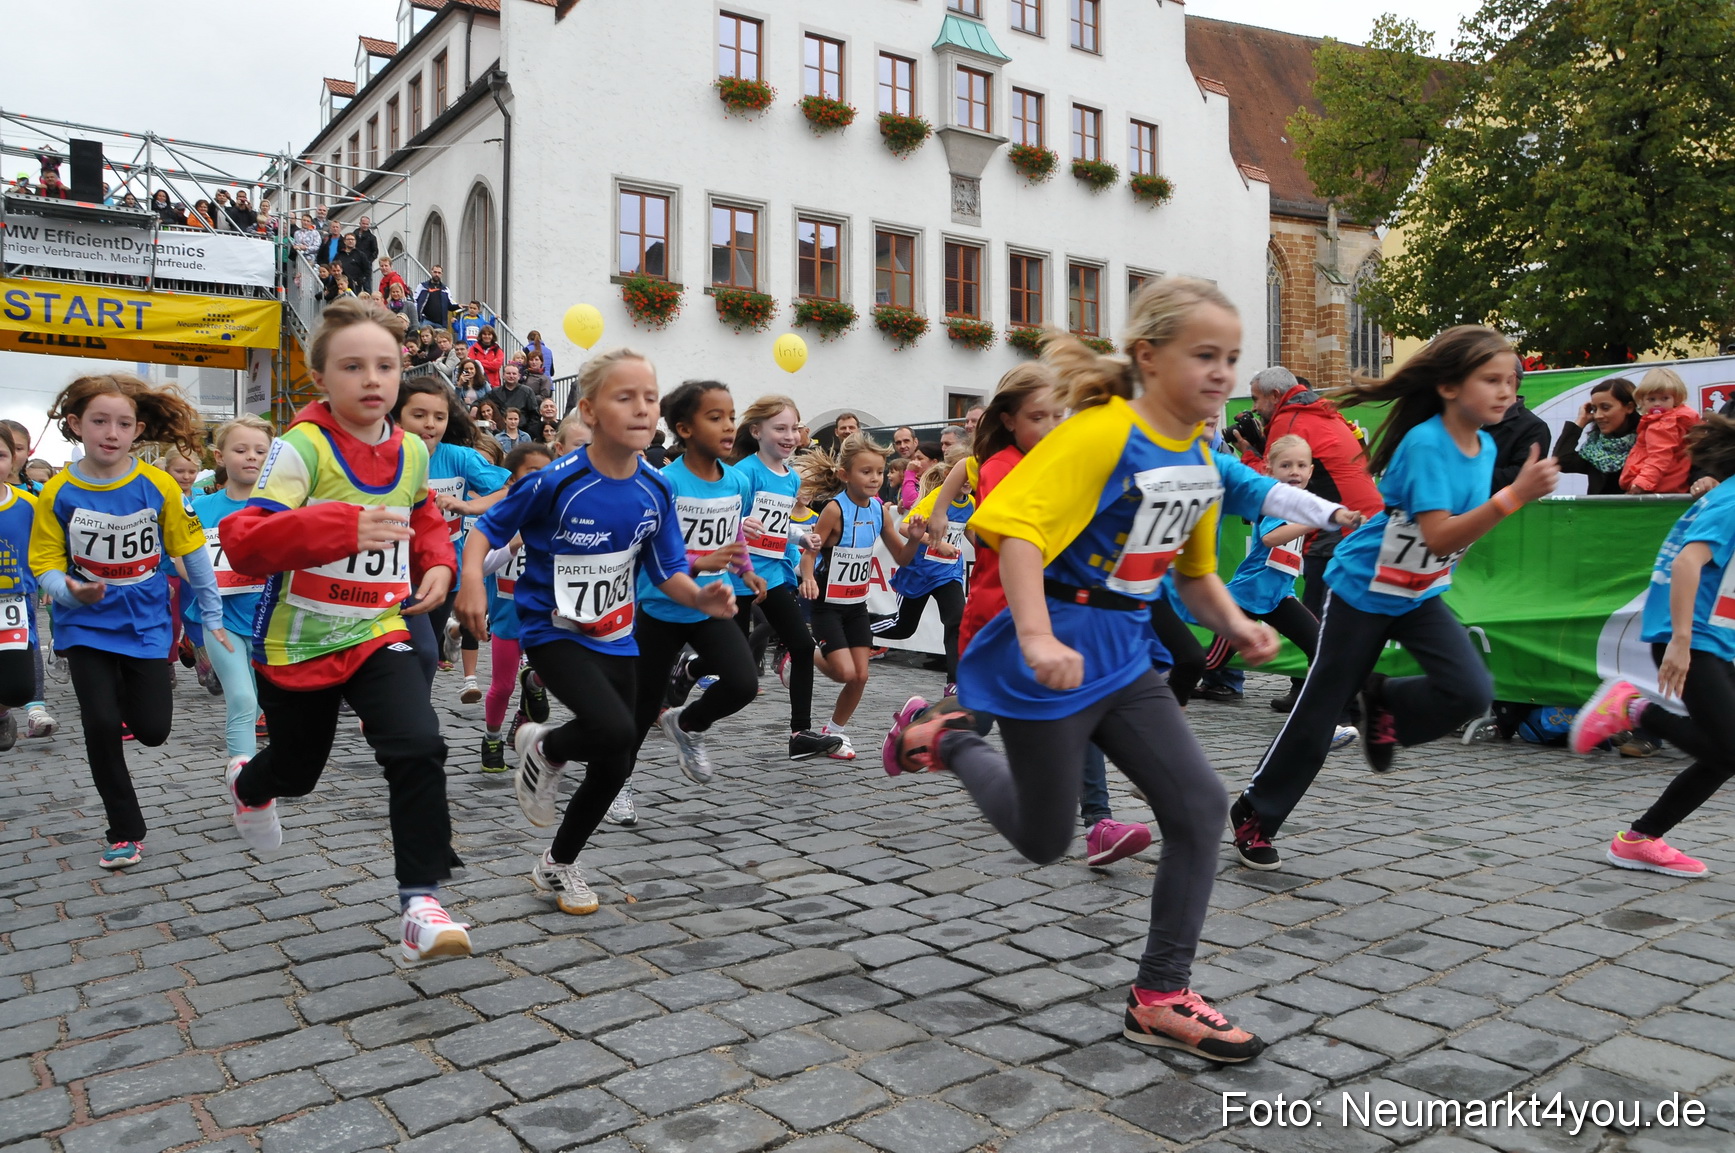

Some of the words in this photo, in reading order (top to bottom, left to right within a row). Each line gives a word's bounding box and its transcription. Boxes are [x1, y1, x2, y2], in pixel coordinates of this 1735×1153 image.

[3, 224, 39, 240] MW
[44, 228, 205, 258] EfficientDynamics
[3, 242, 41, 255] eniger
[42, 245, 107, 261] Verbrauch.
[110, 253, 139, 265] Mehr
[143, 256, 206, 271] Fhrfreude.
[4, 289, 152, 331] START
[176, 321, 222, 329] Neumarkter
[224, 323, 259, 332] Stadtlauf
[433, 485, 454, 493] markt
[677, 505, 705, 514] PARTL
[755, 497, 776, 507] PARTL
[73, 516, 105, 529] PARTL
[107, 517, 148, 531] Neumarkt
[683, 515, 736, 546] 7504
[759, 507, 791, 534] 722
[1144, 496, 1222, 546] 720
[80, 526, 154, 560] 7156
[833, 552, 855, 560] PARTL
[101, 566, 134, 577] Sofia
[557, 565, 596, 575] PARTL
[837, 561, 870, 582] 708
[328, 583, 379, 604] Selina
[567, 568, 630, 618] 7083
